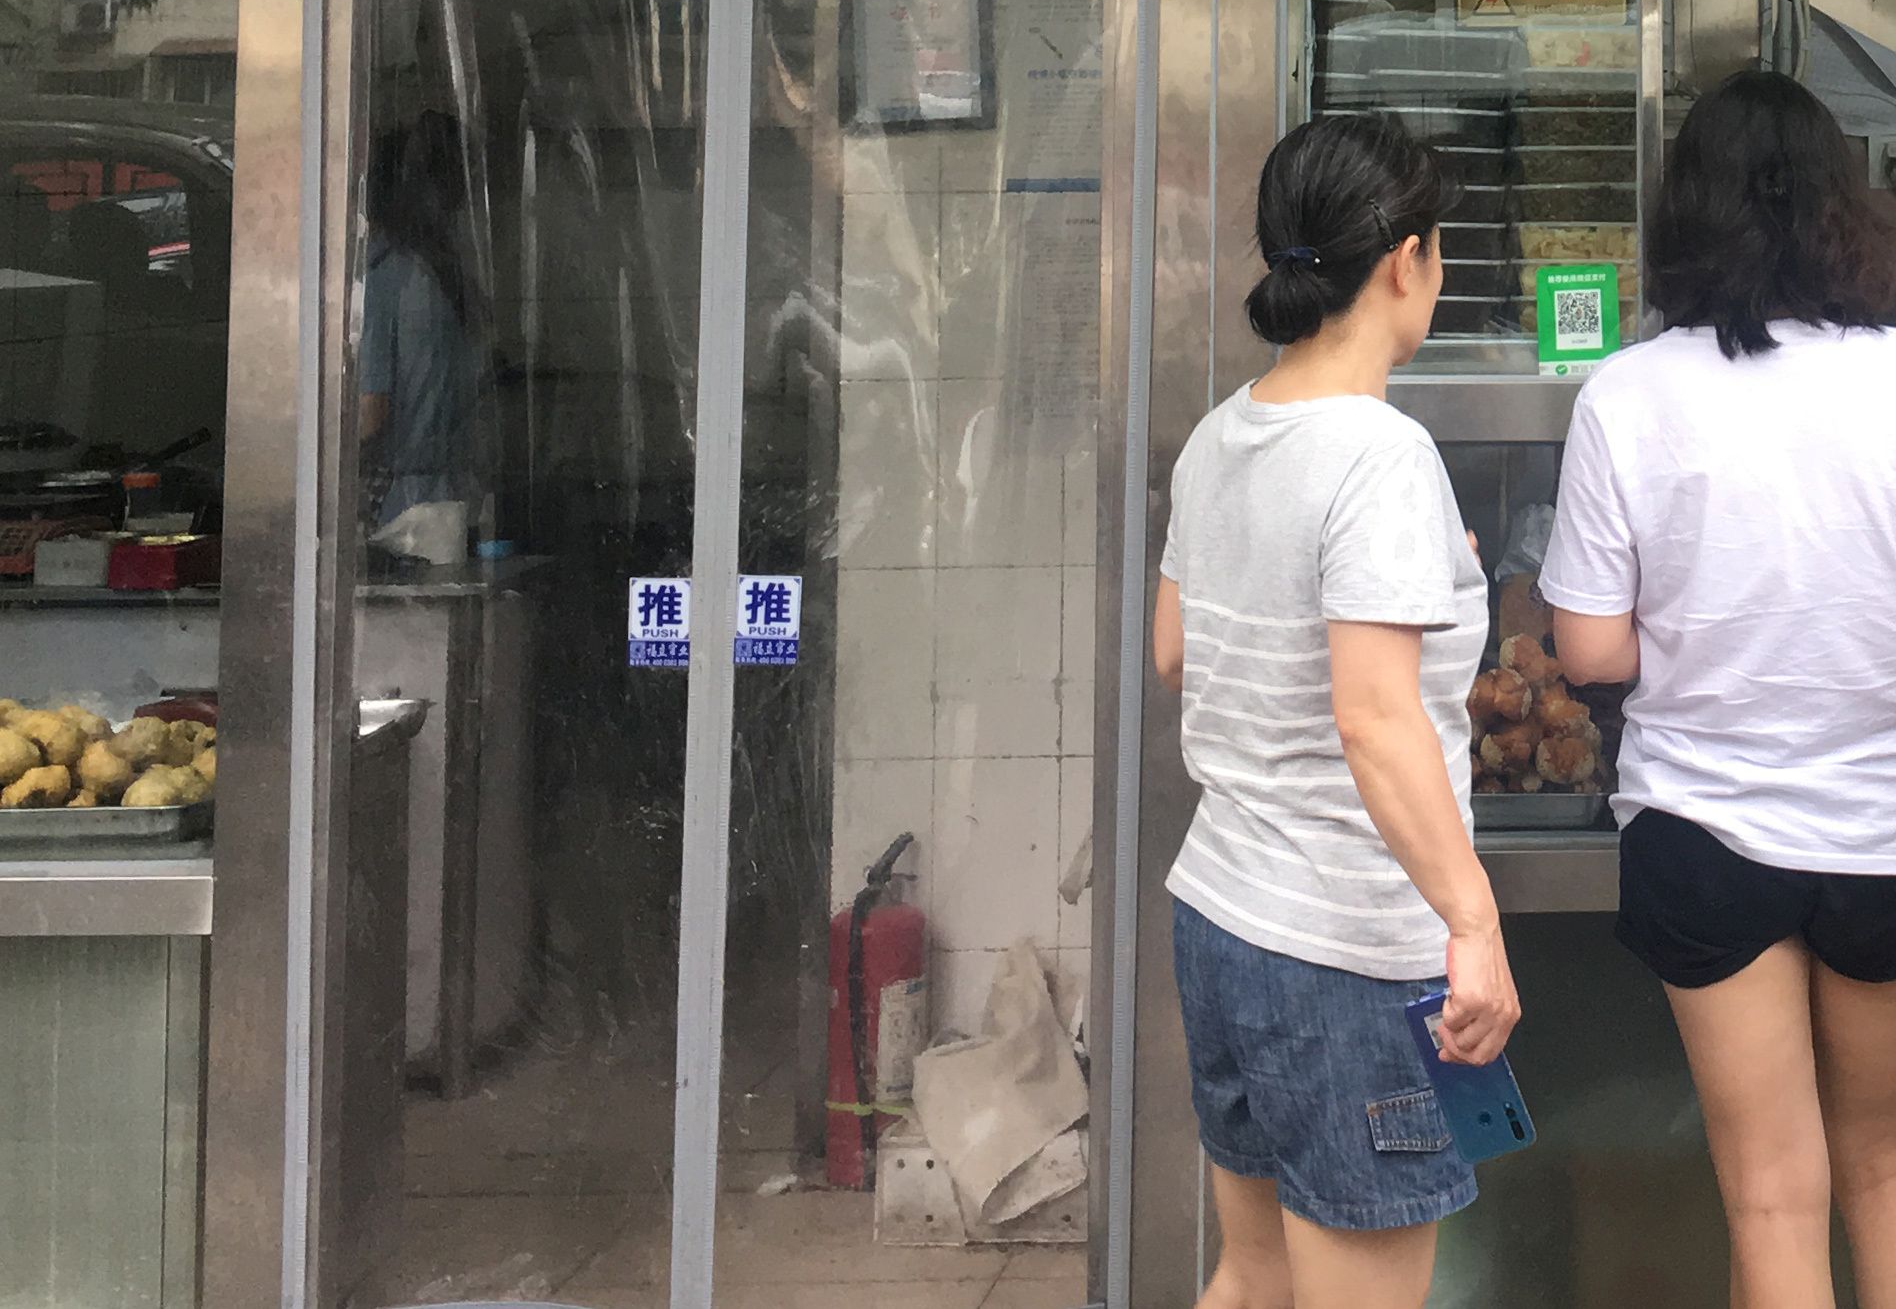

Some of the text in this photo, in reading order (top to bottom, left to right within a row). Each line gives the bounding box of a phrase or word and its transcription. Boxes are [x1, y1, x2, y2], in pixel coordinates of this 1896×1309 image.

[638, 584, 683, 627] 推
[745, 582, 791, 625] 推
[643, 629, 679, 638] PUSH
[749, 627, 786, 636] PUSH
